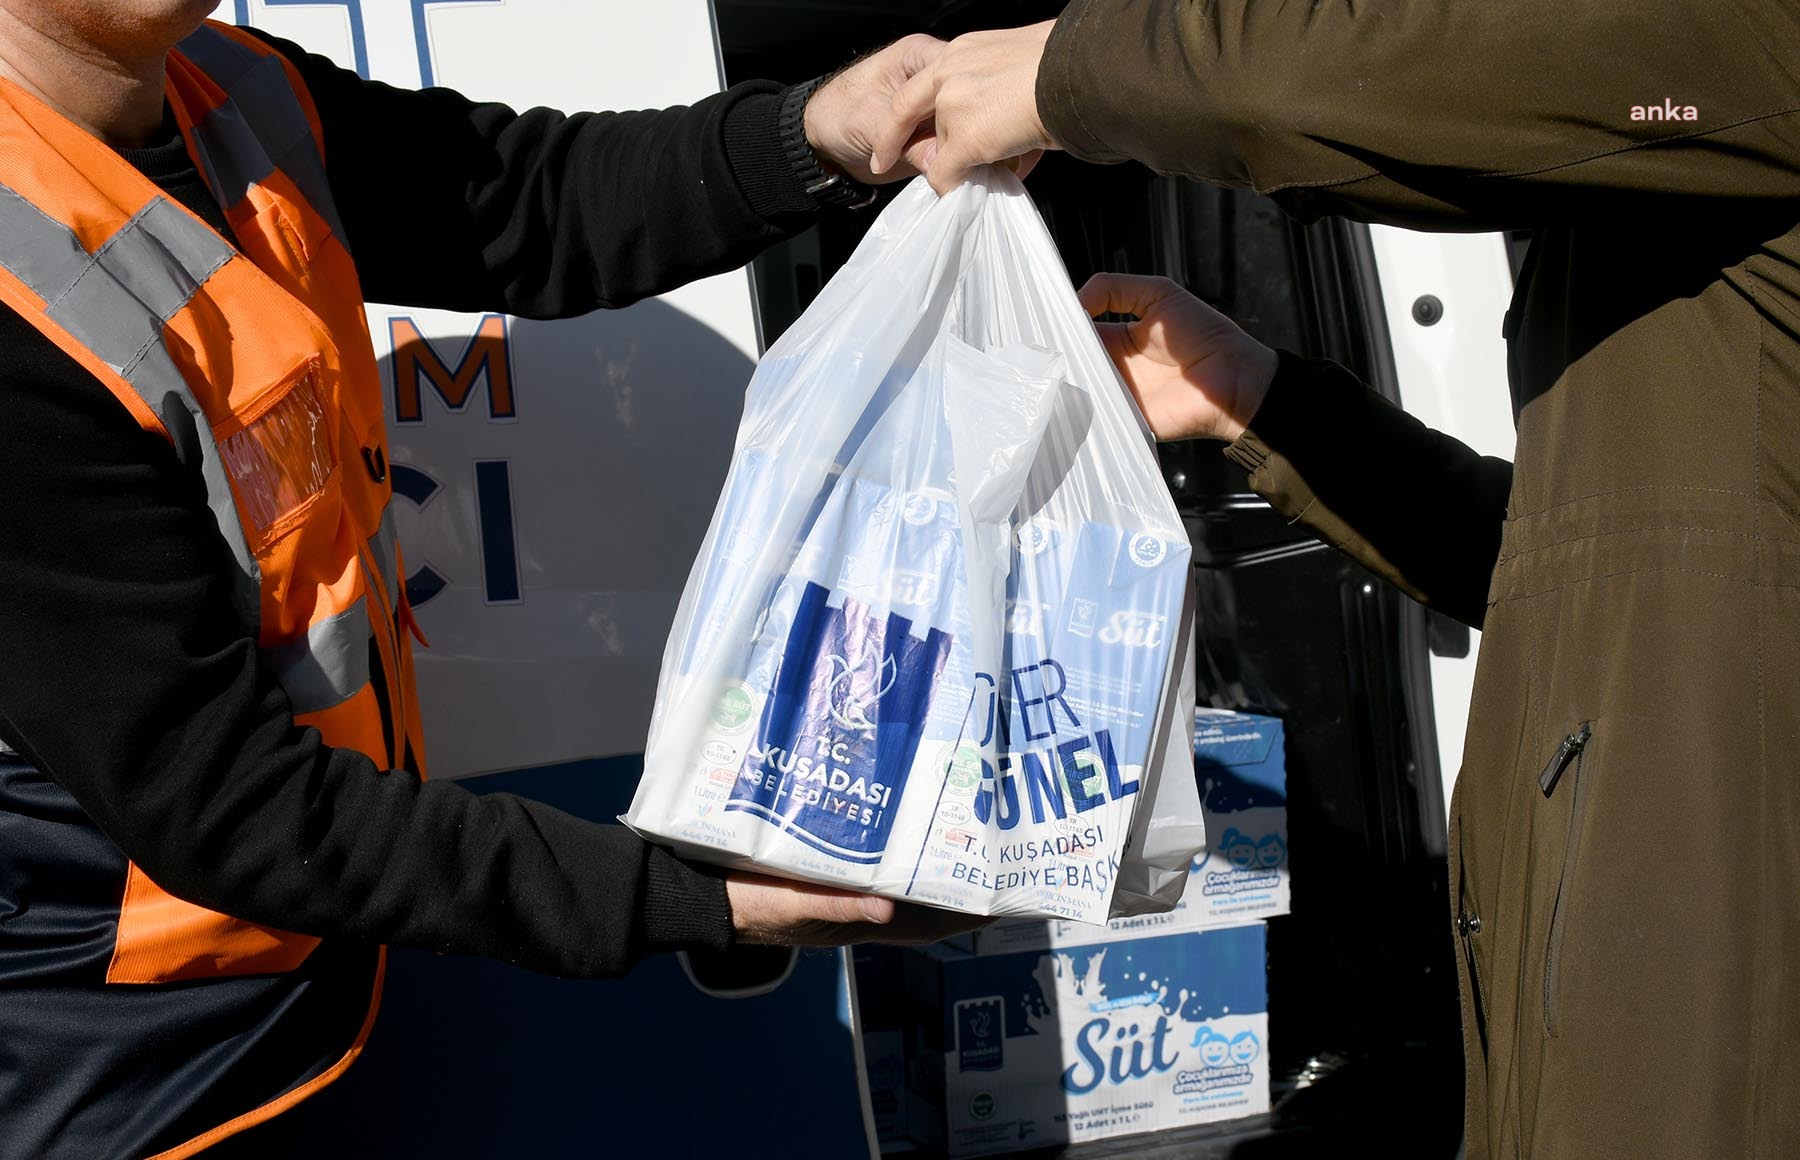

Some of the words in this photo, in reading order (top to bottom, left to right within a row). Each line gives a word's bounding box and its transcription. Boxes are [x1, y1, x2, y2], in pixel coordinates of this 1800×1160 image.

[1098, 610, 1161, 649] Süt
[817, 736, 851, 765] T.C.
[1000, 825, 1103, 863] KUŞADASI
[952, 862, 1057, 890] BELEDİYE
[1066, 850, 1120, 900] BAŞK
[1122, 919, 1144, 929] Adet
[1061, 1016, 1179, 1094] Süt
